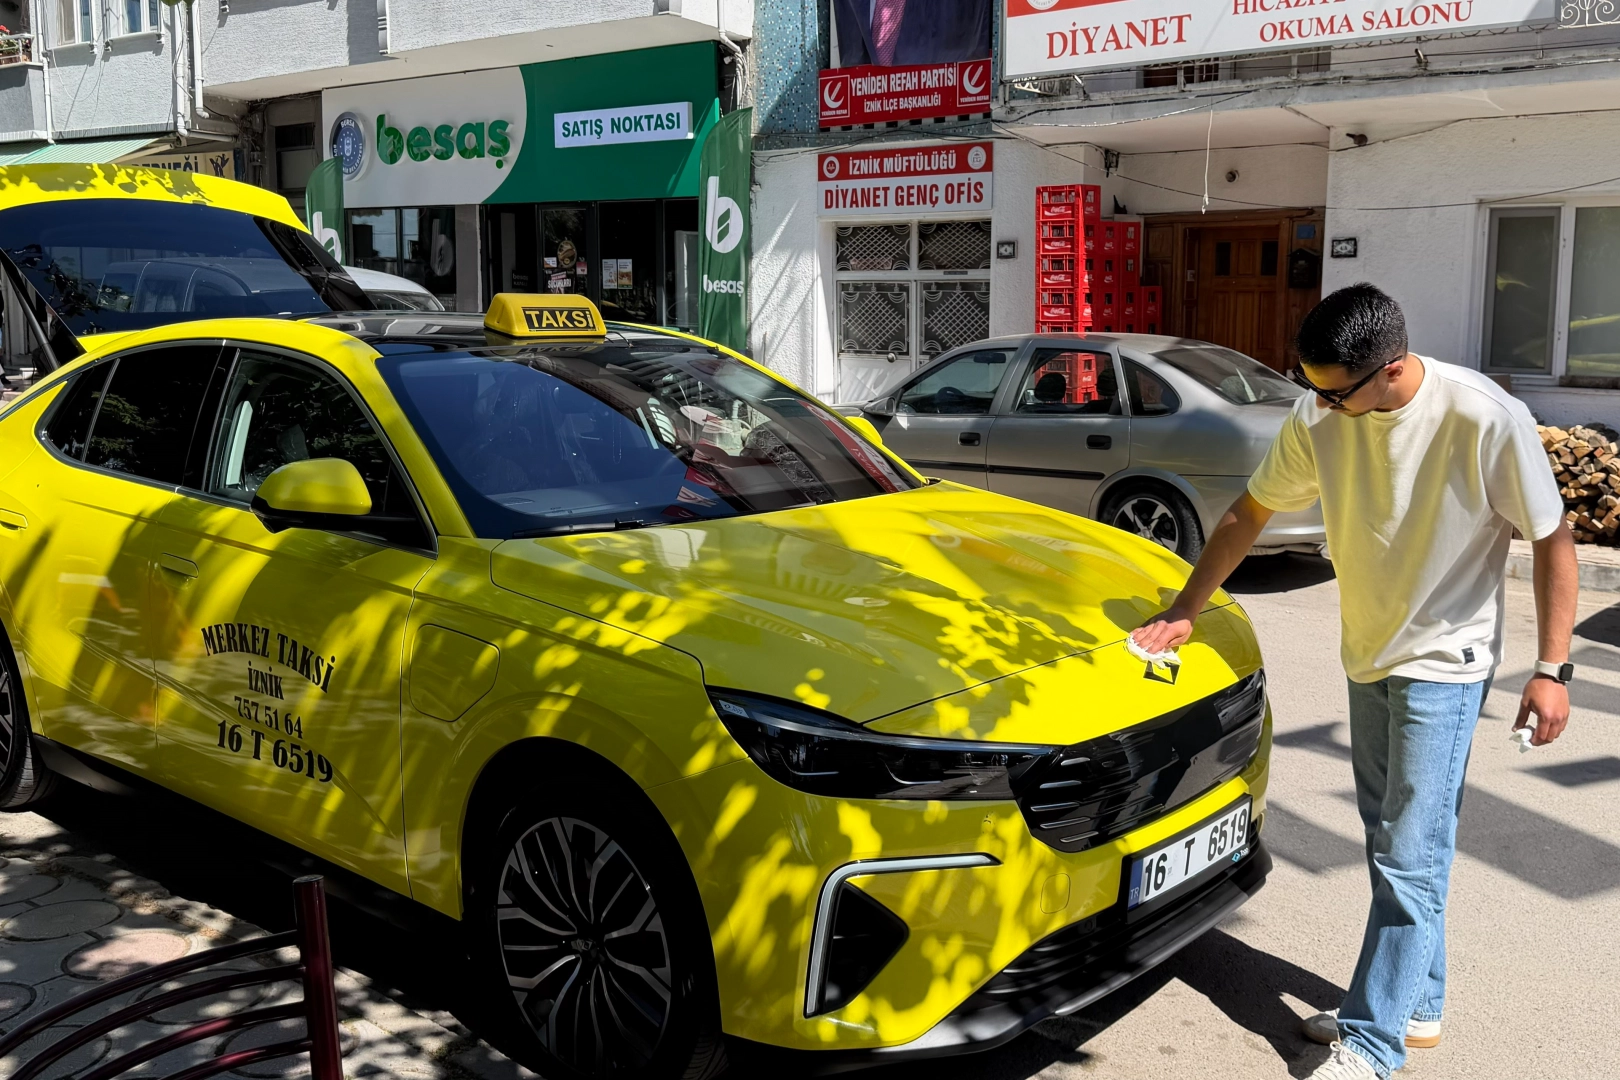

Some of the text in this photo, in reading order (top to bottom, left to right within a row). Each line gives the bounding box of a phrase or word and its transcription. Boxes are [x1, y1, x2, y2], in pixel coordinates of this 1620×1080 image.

[1046, 14, 1192, 59] DİYANET
[1259, 0, 1474, 42] OKUMA SALONU
[850, 62, 957, 97] YENİDEN REFAH PARTİSİ
[864, 92, 941, 113] İZNİK İLÇE BAŞKANLIĞI
[376, 114, 511, 169] besaş
[562, 112, 680, 139] SATIŞ NOKTASI
[849, 150, 956, 175] İZNİK MÜFTÜLÜĞÜ
[824, 177, 984, 209] DİYANET GENÇ OFİS
[703, 274, 745, 298] besaş
[201, 622, 336, 694] MERKEZ TAKSİ
[248, 660, 285, 700] İZNİK
[234, 696, 303, 739] 757 51 64
[217, 720, 333, 783] 16 T 6519
[1130, 808, 1248, 900] TR 16 T 6519
